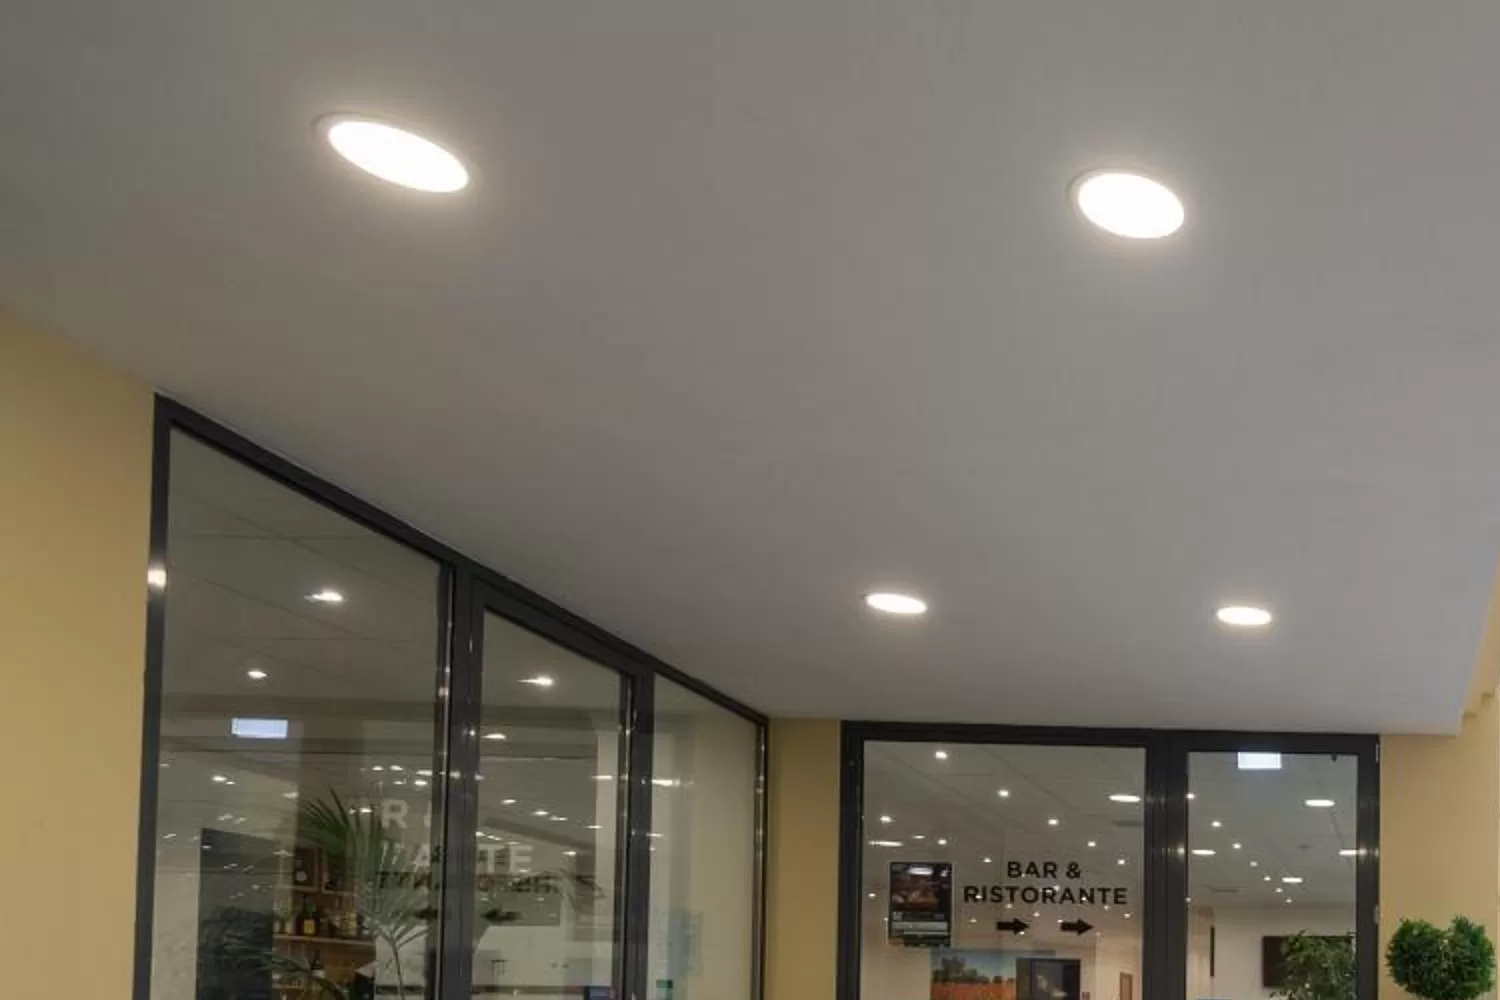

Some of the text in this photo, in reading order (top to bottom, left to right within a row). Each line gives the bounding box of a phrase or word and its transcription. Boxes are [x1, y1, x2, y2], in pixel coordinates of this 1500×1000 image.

[1007, 861, 1081, 879] BAR &
[963, 886, 1128, 905] RISTORANTE
